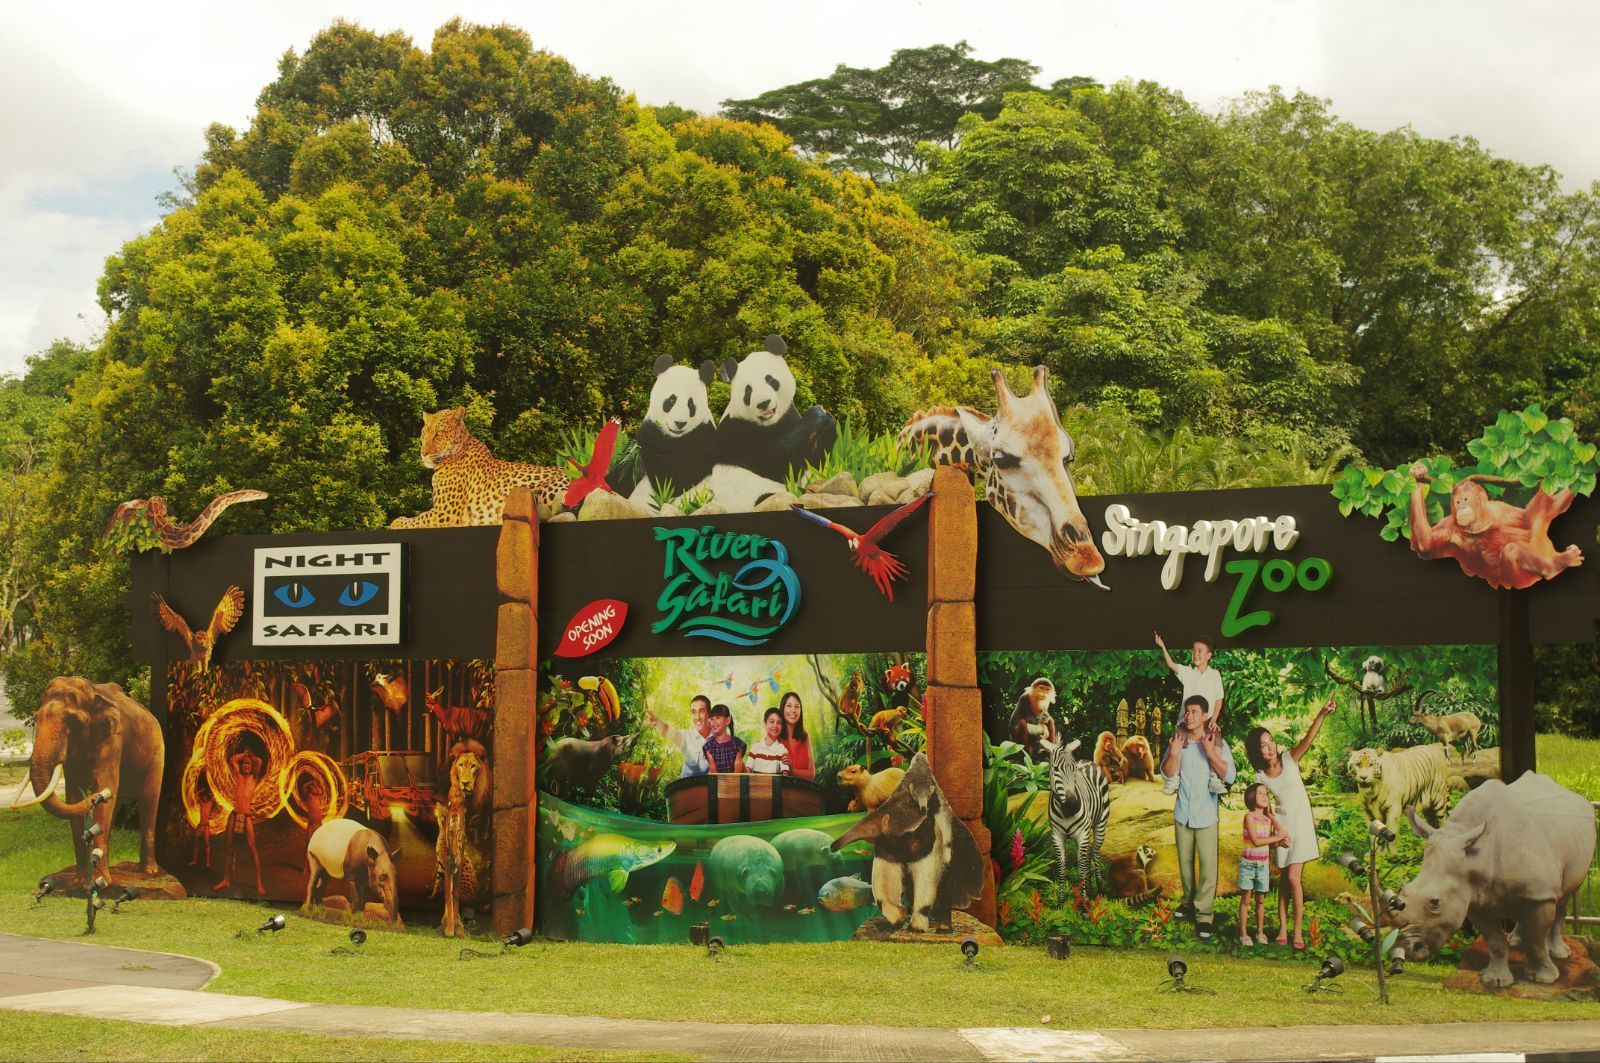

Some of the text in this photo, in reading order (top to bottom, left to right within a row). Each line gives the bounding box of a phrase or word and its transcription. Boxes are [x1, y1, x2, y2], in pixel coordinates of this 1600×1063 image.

[264, 552, 391, 569] NIGHT
[652, 525, 769, 585] River
[1101, 503, 1300, 591] Singapore
[651, 571, 784, 634] Safari
[262, 622, 389, 638] SAFARI
[567, 604, 616, 642] OPENING
[582, 623, 613, 651] SOON
